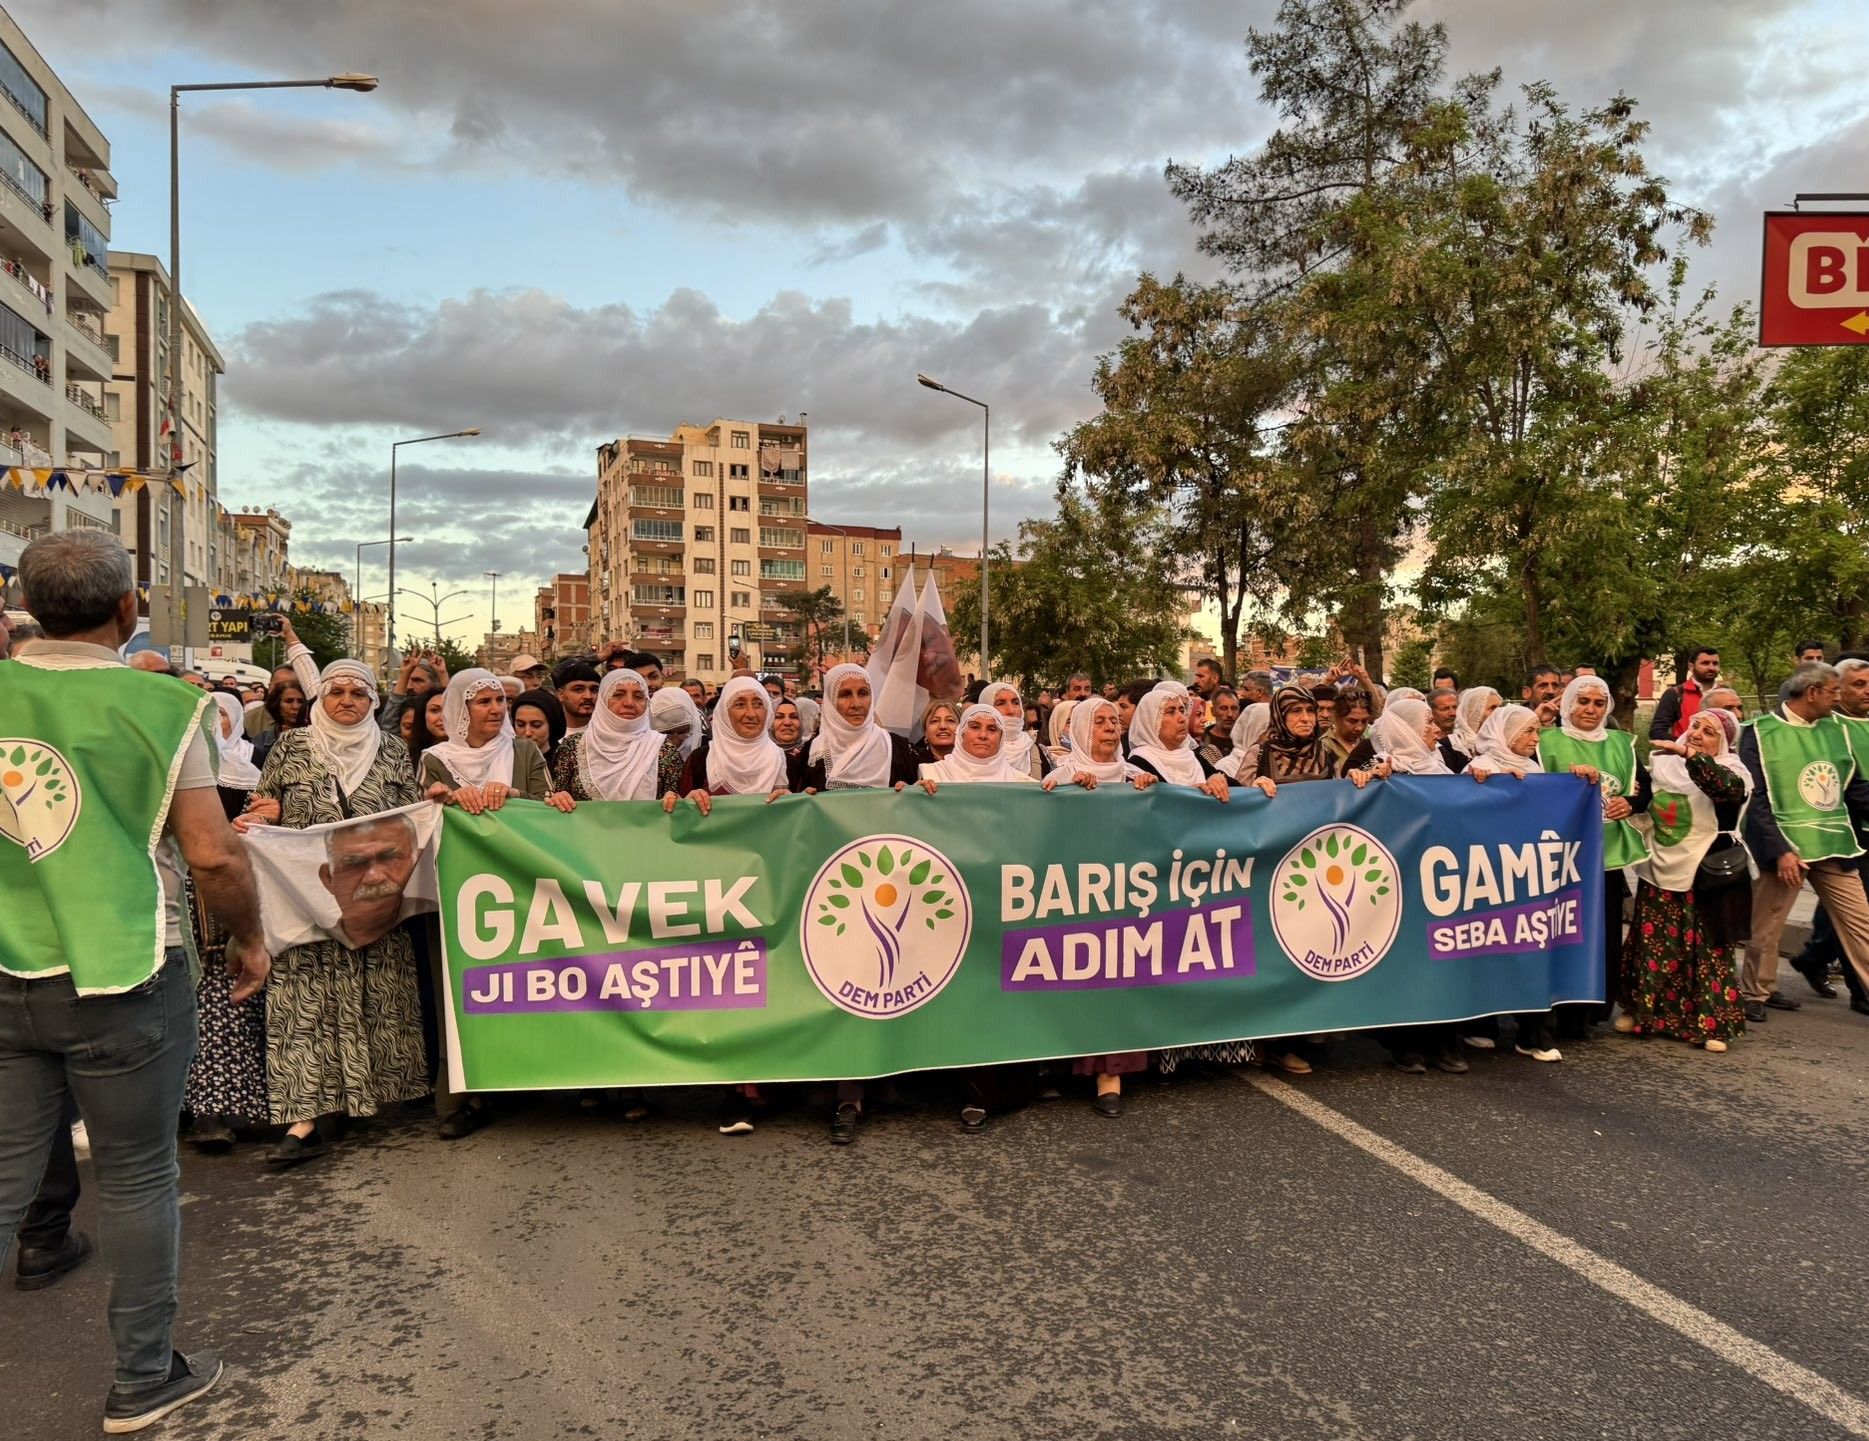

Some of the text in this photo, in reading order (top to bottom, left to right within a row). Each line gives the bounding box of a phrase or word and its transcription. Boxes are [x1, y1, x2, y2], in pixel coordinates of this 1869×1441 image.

[221, 621, 248, 633] YAPI
[1001, 848, 1255, 922] BARIŞ İÇİN
[1419, 829, 1582, 917] GAMÊK
[457, 873, 763, 960] GAVEK
[1010, 905, 1242, 982] ADIM AT
[1433, 918, 1508, 952] SEBA
[470, 942, 760, 1008] JI BO AŞTIYÊ
[1304, 940, 1374, 973] DEM PARTİ
[838, 971, 933, 1009] DEM PARTİ
